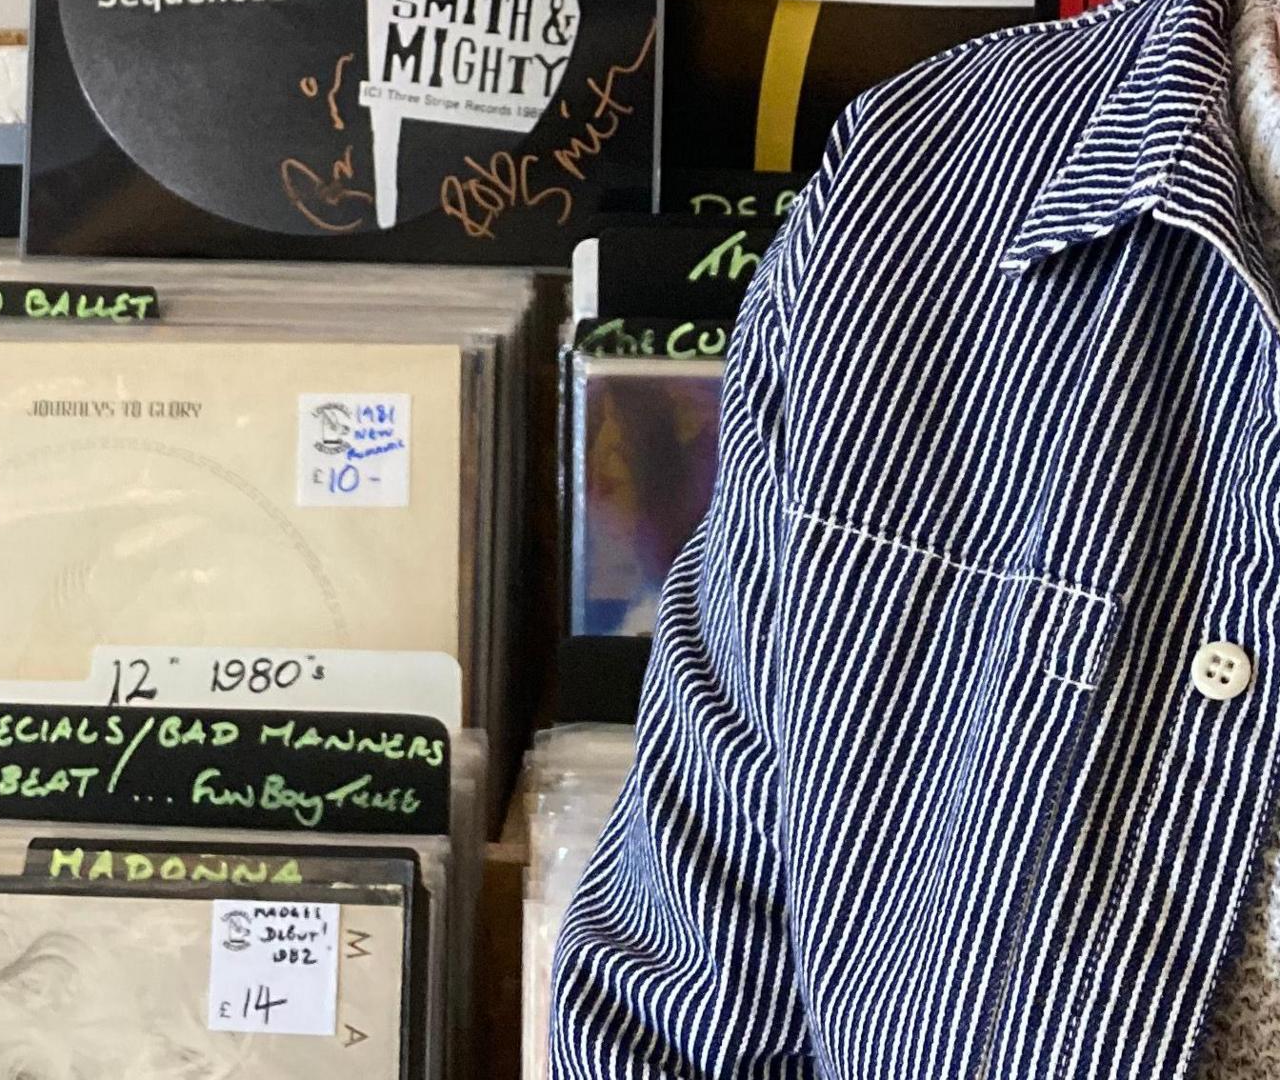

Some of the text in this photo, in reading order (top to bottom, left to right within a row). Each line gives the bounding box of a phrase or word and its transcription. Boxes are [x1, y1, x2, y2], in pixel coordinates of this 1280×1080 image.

[382, 21, 570, 98] MIGHTY
[388, 89, 421, 105] Three
[424, 94, 461, 109] Stripe
[465, 98, 513, 116] Records
[25, 287, 155, 322] BALLET
[121, 400, 142, 418] TO
[149, 400, 202, 419] GLORY
[260, 719, 446, 768] MANNERS
[49, 847, 304, 886] MADONNA
